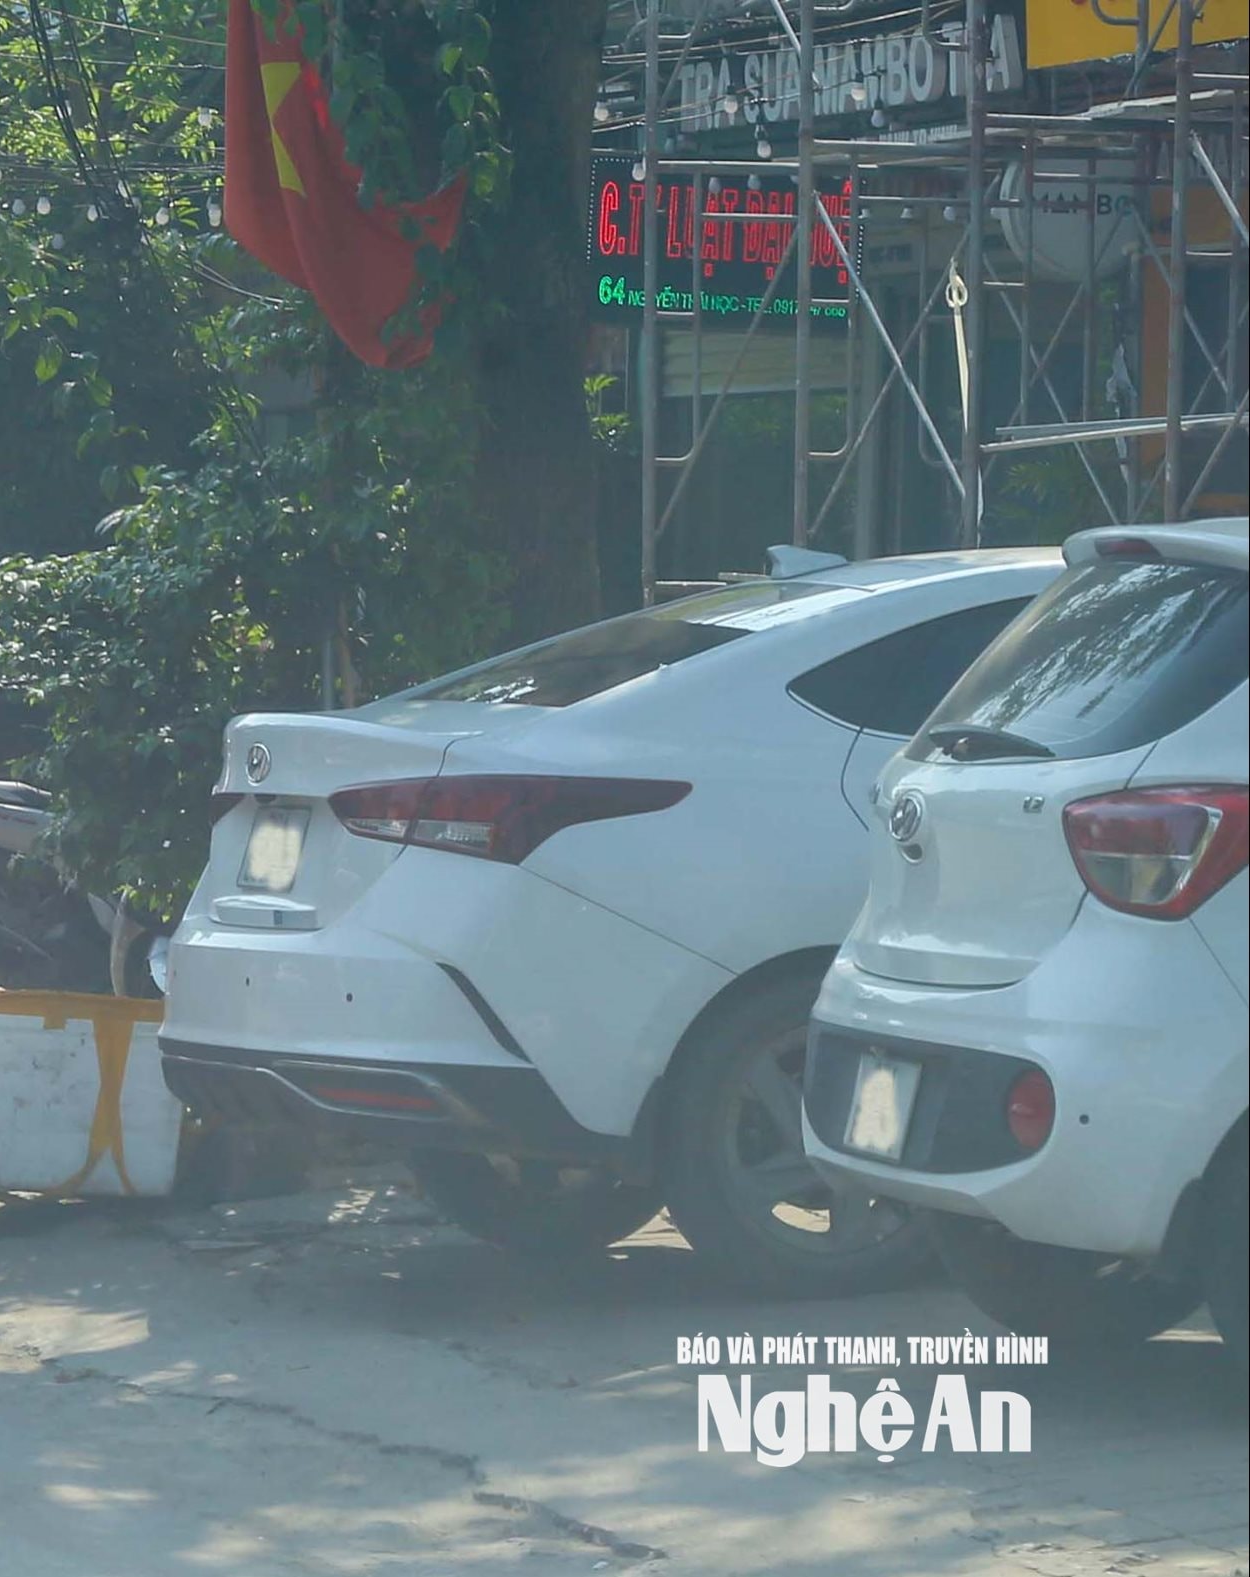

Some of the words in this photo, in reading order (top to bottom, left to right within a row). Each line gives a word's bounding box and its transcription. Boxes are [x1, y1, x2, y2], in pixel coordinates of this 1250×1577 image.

[941, 14, 1018, 98] TA
[599, 181, 663, 256] C.T
[599, 275, 626, 306] 64
[628, 286, 680, 309] NGYỄN
